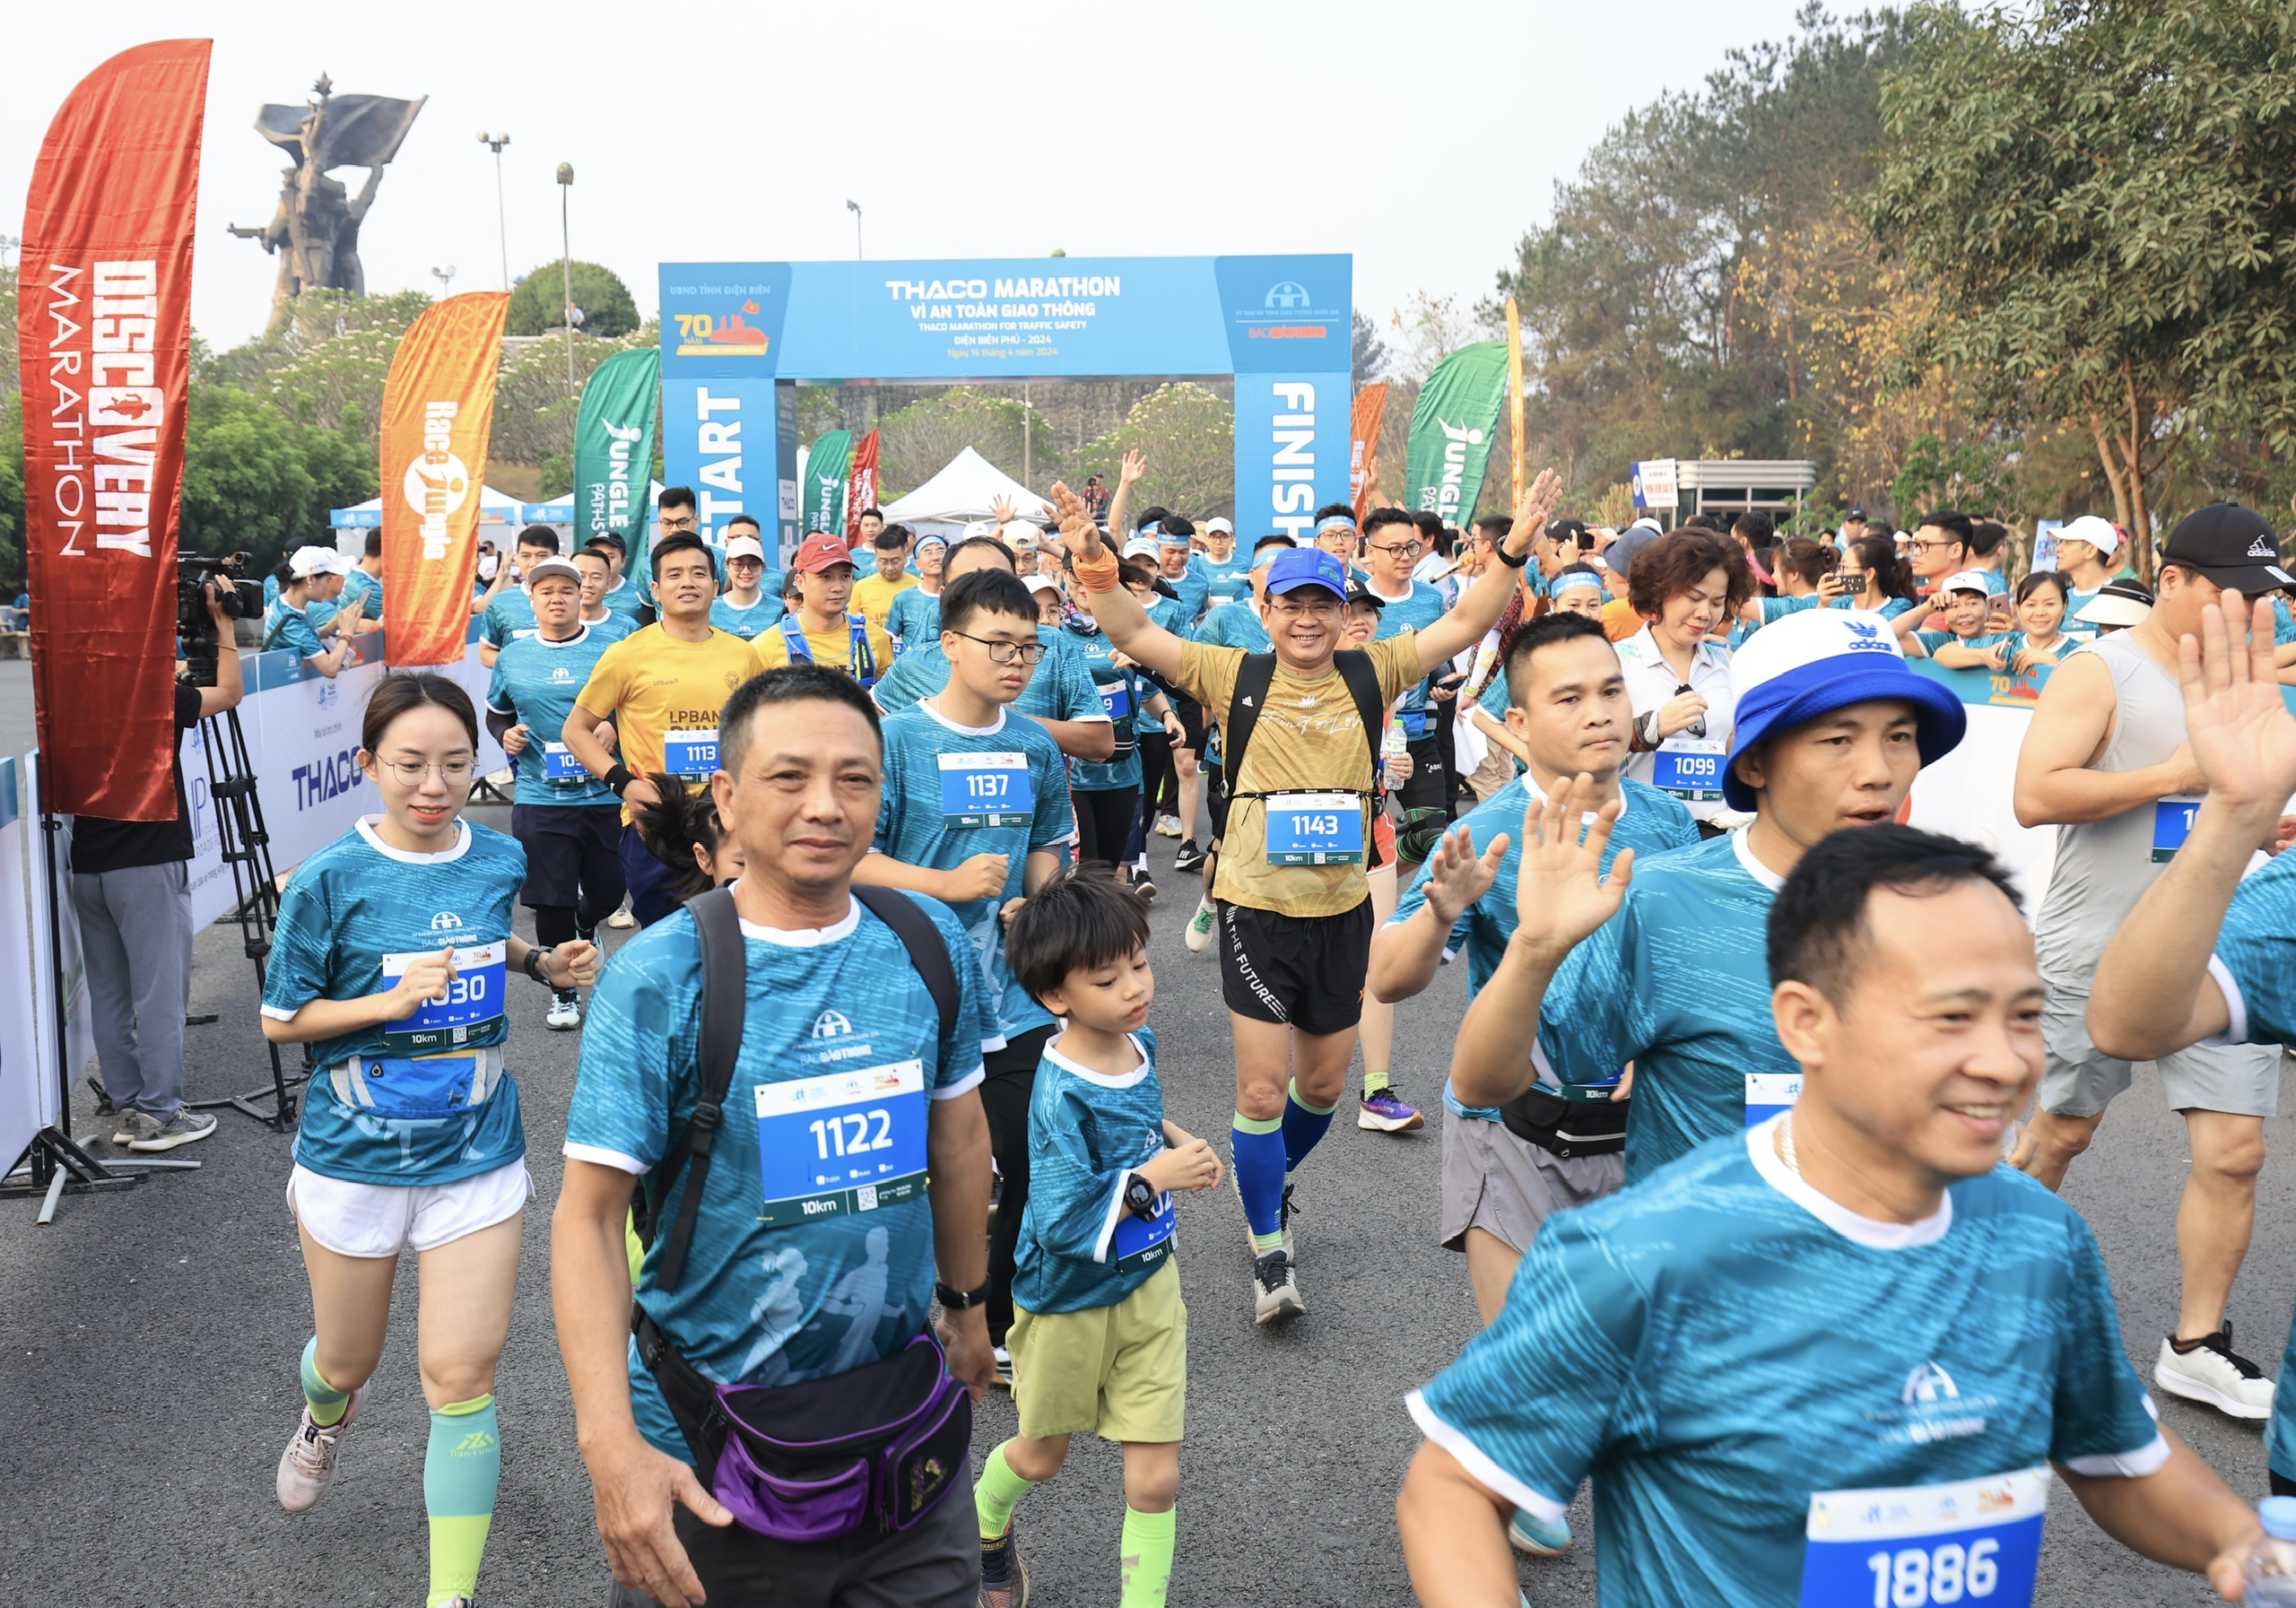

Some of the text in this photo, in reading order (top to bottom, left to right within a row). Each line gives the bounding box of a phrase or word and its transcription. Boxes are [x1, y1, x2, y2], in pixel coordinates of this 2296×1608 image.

[670, 285, 697, 295] UBND
[885, 276, 1120, 300] THACO MARATHON
[910, 300, 1096, 318] VÌ AN TOÀN GIAO THÔNG
[674, 314, 713, 338] 70
[918, 320, 1087, 332] THACO MARATHON FOR TRAFFIC SAFETY
[954, 334, 976, 346] ĐIỆN
[978, 333, 998, 345] BIÊN
[1001, 333, 1021, 345] PHỦ
[1028, 335, 1051, 344] 2024
[1036, 347, 1058, 356] 2024
[48, 264, 85, 556] MARATHON
[423, 401, 458, 465] Race
[601, 416, 643, 528] JUNGLE
[1271, 382, 1316, 548] FINISH
[586, 483, 605, 530] PATHS
[817, 472, 839, 534] JUNGL
[809, 512, 819, 530] PAT
[2247, 549, 2276, 558] adidas
[1848, 639, 1892, 652] adidas
[1989, 674, 2011, 691] 70
[669, 709, 721, 724] LPBAN
[559, 754, 582, 768] 10
[686, 745, 717, 761] 1113
[1674, 757, 1716, 776] 1099
[291, 744, 364, 812] THACO
[966, 774, 1009, 796] 1137
[1292, 815, 1338, 835] 1143
[1229, 925, 1242, 952] THE
[1236, 953, 1276, 1005] FUTURE
[422, 974, 485, 1007] 030
[412, 1034, 437, 1044] 10km
[1585, 1091, 1608, 1099] 10km
[809, 1108, 893, 1160] 1122
[801, 1200, 838, 1215] 10km
[1141, 1247, 1163, 1263] 10km
[1866, 1537, 2001, 1608] 1886
